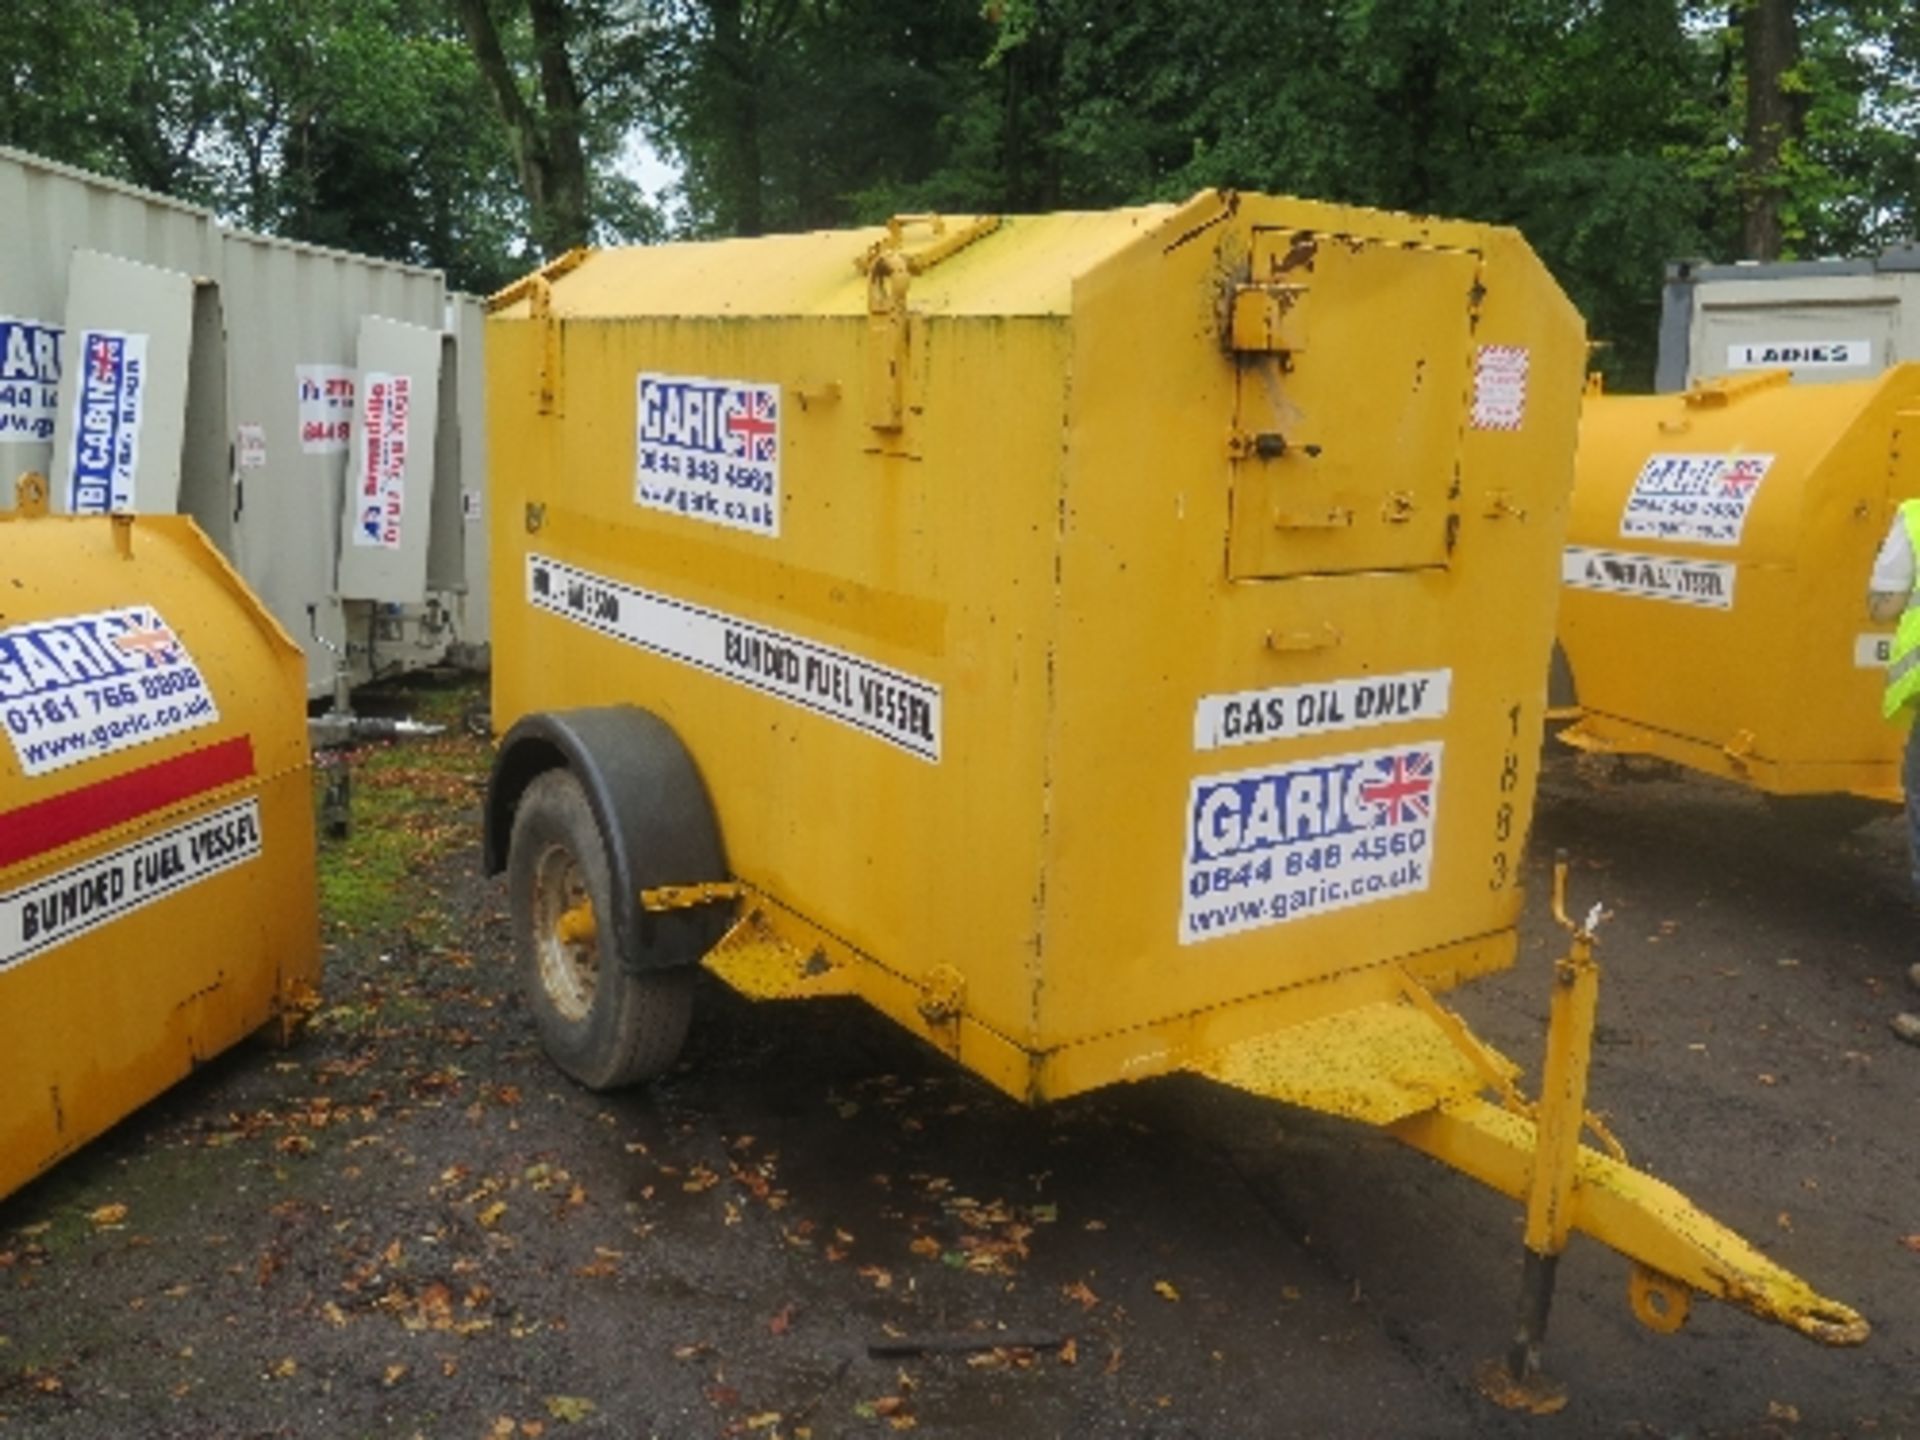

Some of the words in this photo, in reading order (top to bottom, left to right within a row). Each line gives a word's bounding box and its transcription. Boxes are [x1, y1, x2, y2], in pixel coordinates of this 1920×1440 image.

[1746, 345, 1848, 362] LADIES
[806, 656, 853, 708] FUEL
[860, 675, 934, 742] VESSEL
[1223, 698, 1284, 739] GAS
[1296, 690, 1344, 728] OIL
[1355, 679, 1429, 719] ONLY
[1197, 759, 1386, 858] GARIC
[22, 866, 124, 941] BUNDED
[133, 844, 185, 892] FUEL
[189, 813, 259, 864] VESSEL
[1285, 845, 1341, 877] 848
[1351, 829, 1426, 862] 4560
[1189, 860, 1422, 932] www.garic.co.uk
